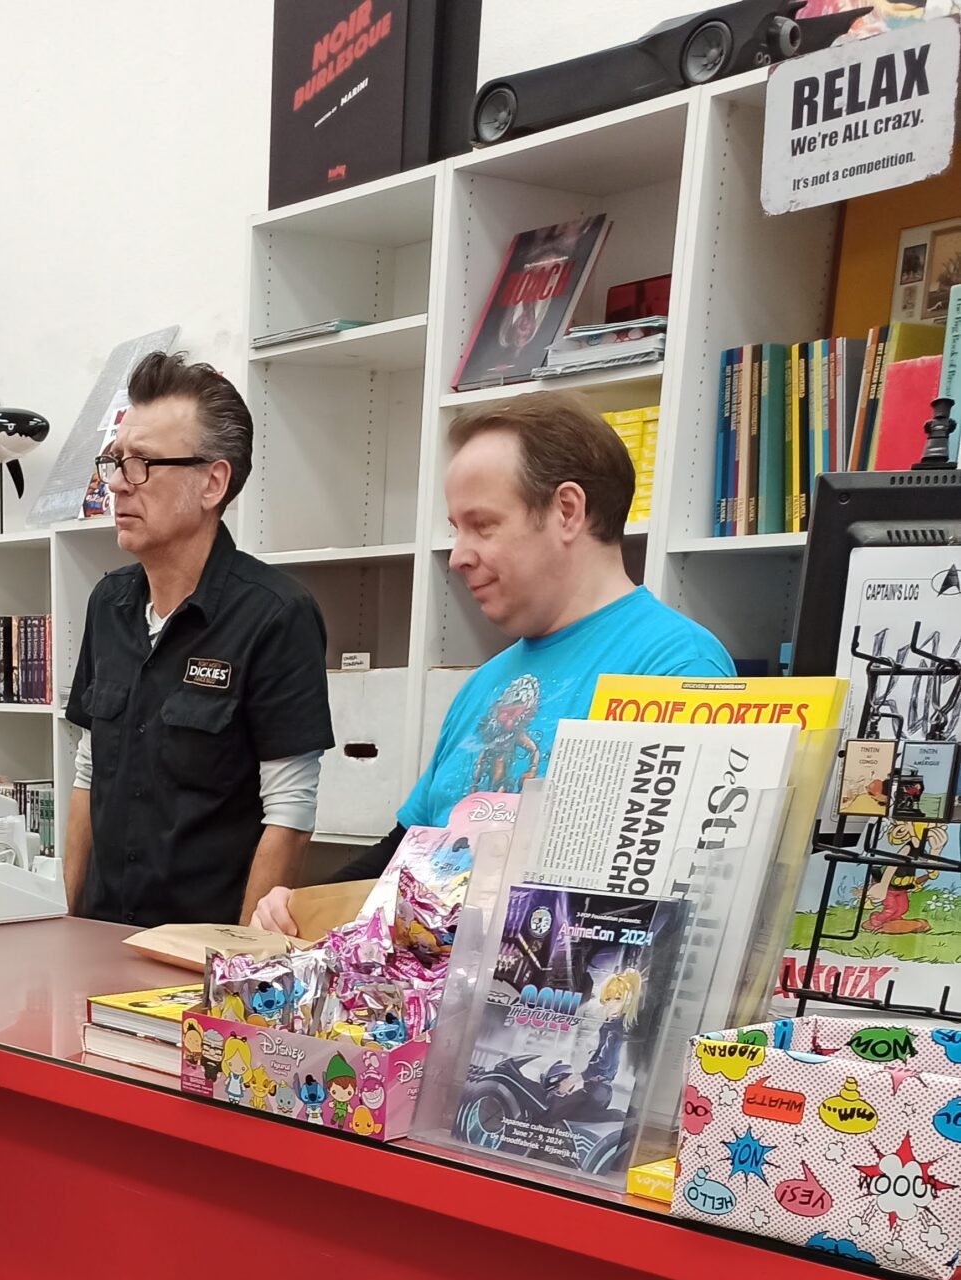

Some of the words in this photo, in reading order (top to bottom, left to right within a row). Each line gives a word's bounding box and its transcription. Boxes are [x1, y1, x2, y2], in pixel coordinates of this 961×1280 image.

[312, 0, 372, 71] NOIR
[292, 11, 392, 111] BURLESQUE
[791, 43, 931, 131] RELAX
[791, 130, 838, 157] We're
[842, 119, 869, 144] ALL
[873, 108, 924, 135] crazy.
[792, 176, 809, 191] It's
[811, 171, 830, 187] not
[832, 170, 839, 180] a
[842, 151, 916, 179] competition.
[866, 583, 903, 600] CAPTAIN'S
[903, 583, 920, 600] LOG
[630, 743, 661, 794] VAN
[722, 745, 750, 785] De
[468, 797, 516, 823] Disn
[627, 745, 686, 895] LEONARDO
[559, 923, 614, 942] AnimeCon
[619, 928, 655, 947] 2024
[256, 1031, 305, 1066] Disney
[703, 1044, 759, 1062] HOORAY
[745, 1094, 804, 1113] WHAT?
[501, 1116, 530, 1129] Japanese
[530, 1123, 555, 1134] cultural
[555, 1128, 581, 1139] festival
[512, 1129, 528, 1138] June
[545, 1136, 563, 1145] 2024
[500, 1135, 539, 1149] Broodfabriek
[733, 1143, 763, 1167] NO!
[687, 1186, 734, 1210] HELLO
[779, 1185, 826, 1210] YES!
